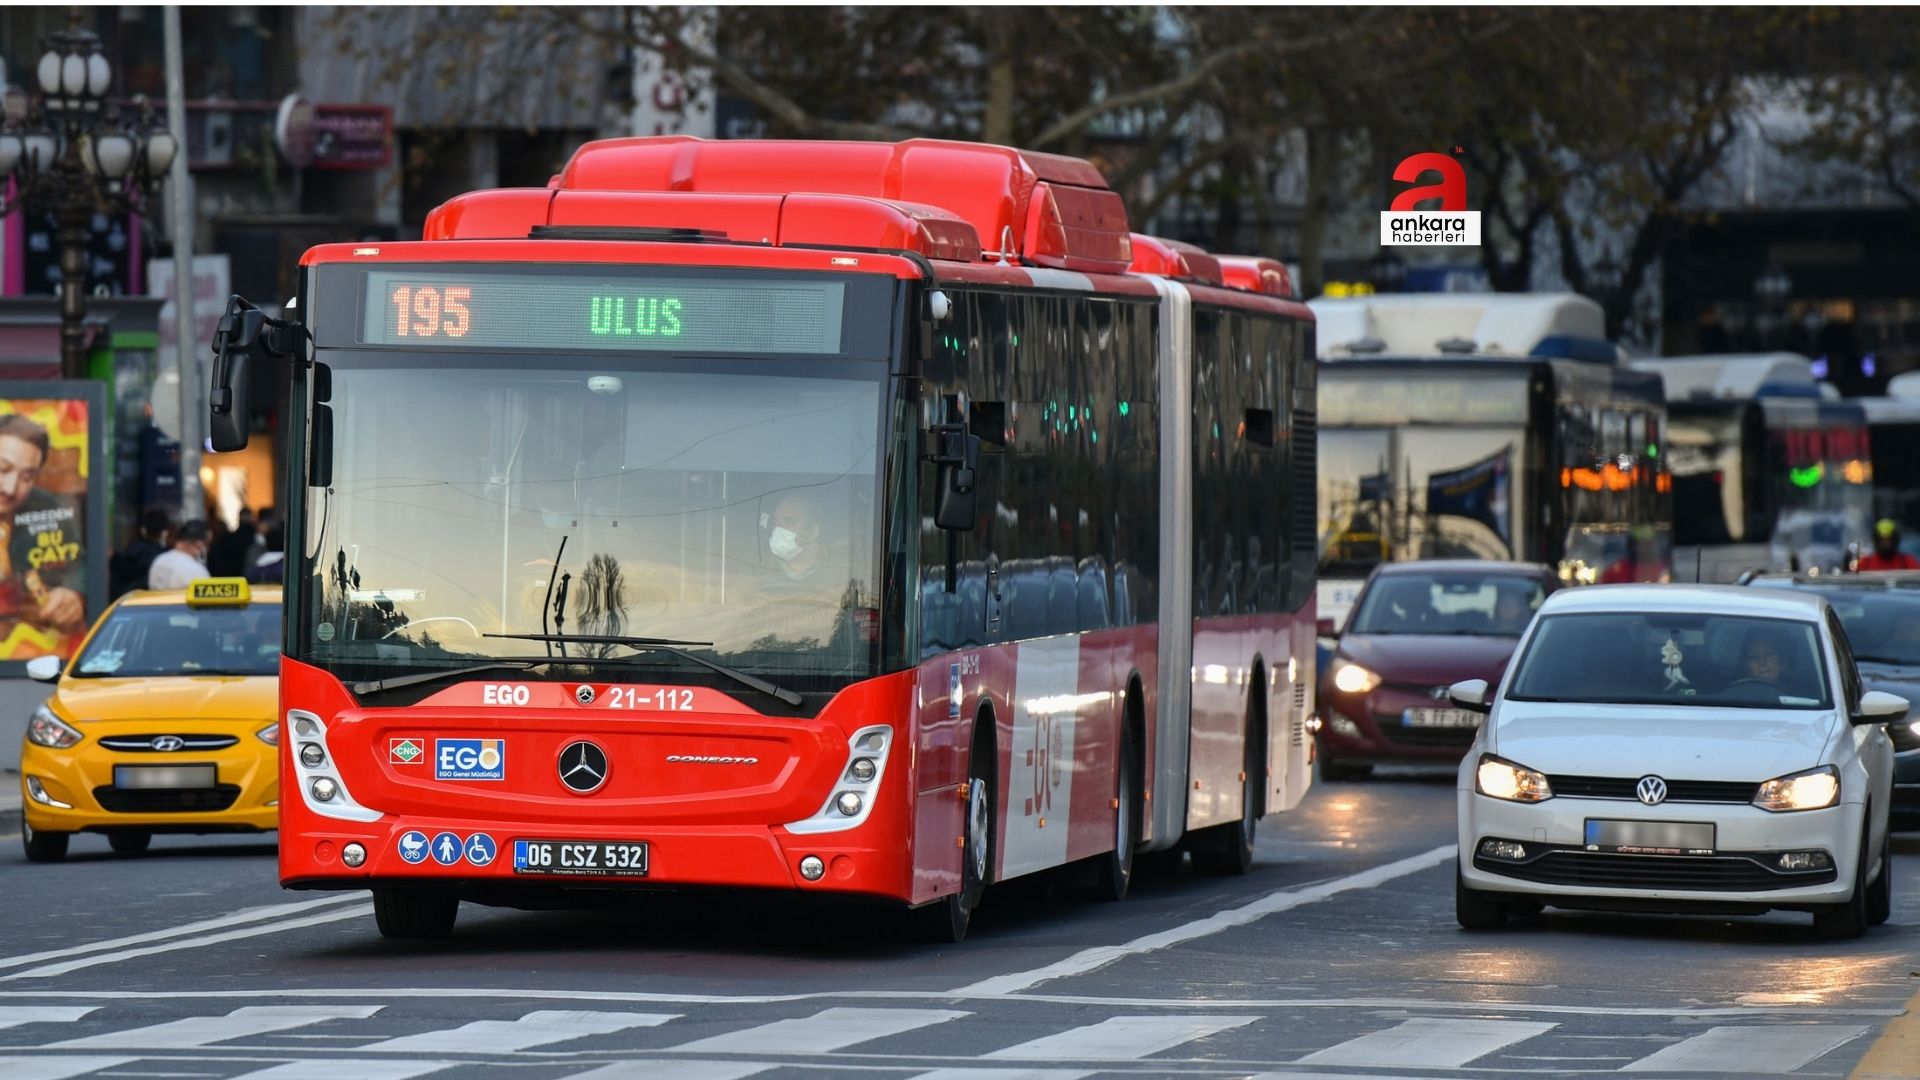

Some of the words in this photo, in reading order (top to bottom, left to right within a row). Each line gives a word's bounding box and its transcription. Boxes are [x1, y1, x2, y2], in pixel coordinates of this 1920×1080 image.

[393, 287, 471, 337] 195
[591, 297, 682, 336] ULUS
[37, 529, 64, 548] BU
[28, 542, 80, 569] ÇAY?
[483, 684, 530, 706] EGO
[396, 746, 417, 755] CNG
[440, 747, 501, 770] EGO
[666, 755, 759, 765] CONECTO
[528, 844, 552, 866] 06
[561, 845, 598, 867] CSZ
[605, 845, 642, 868] 532
